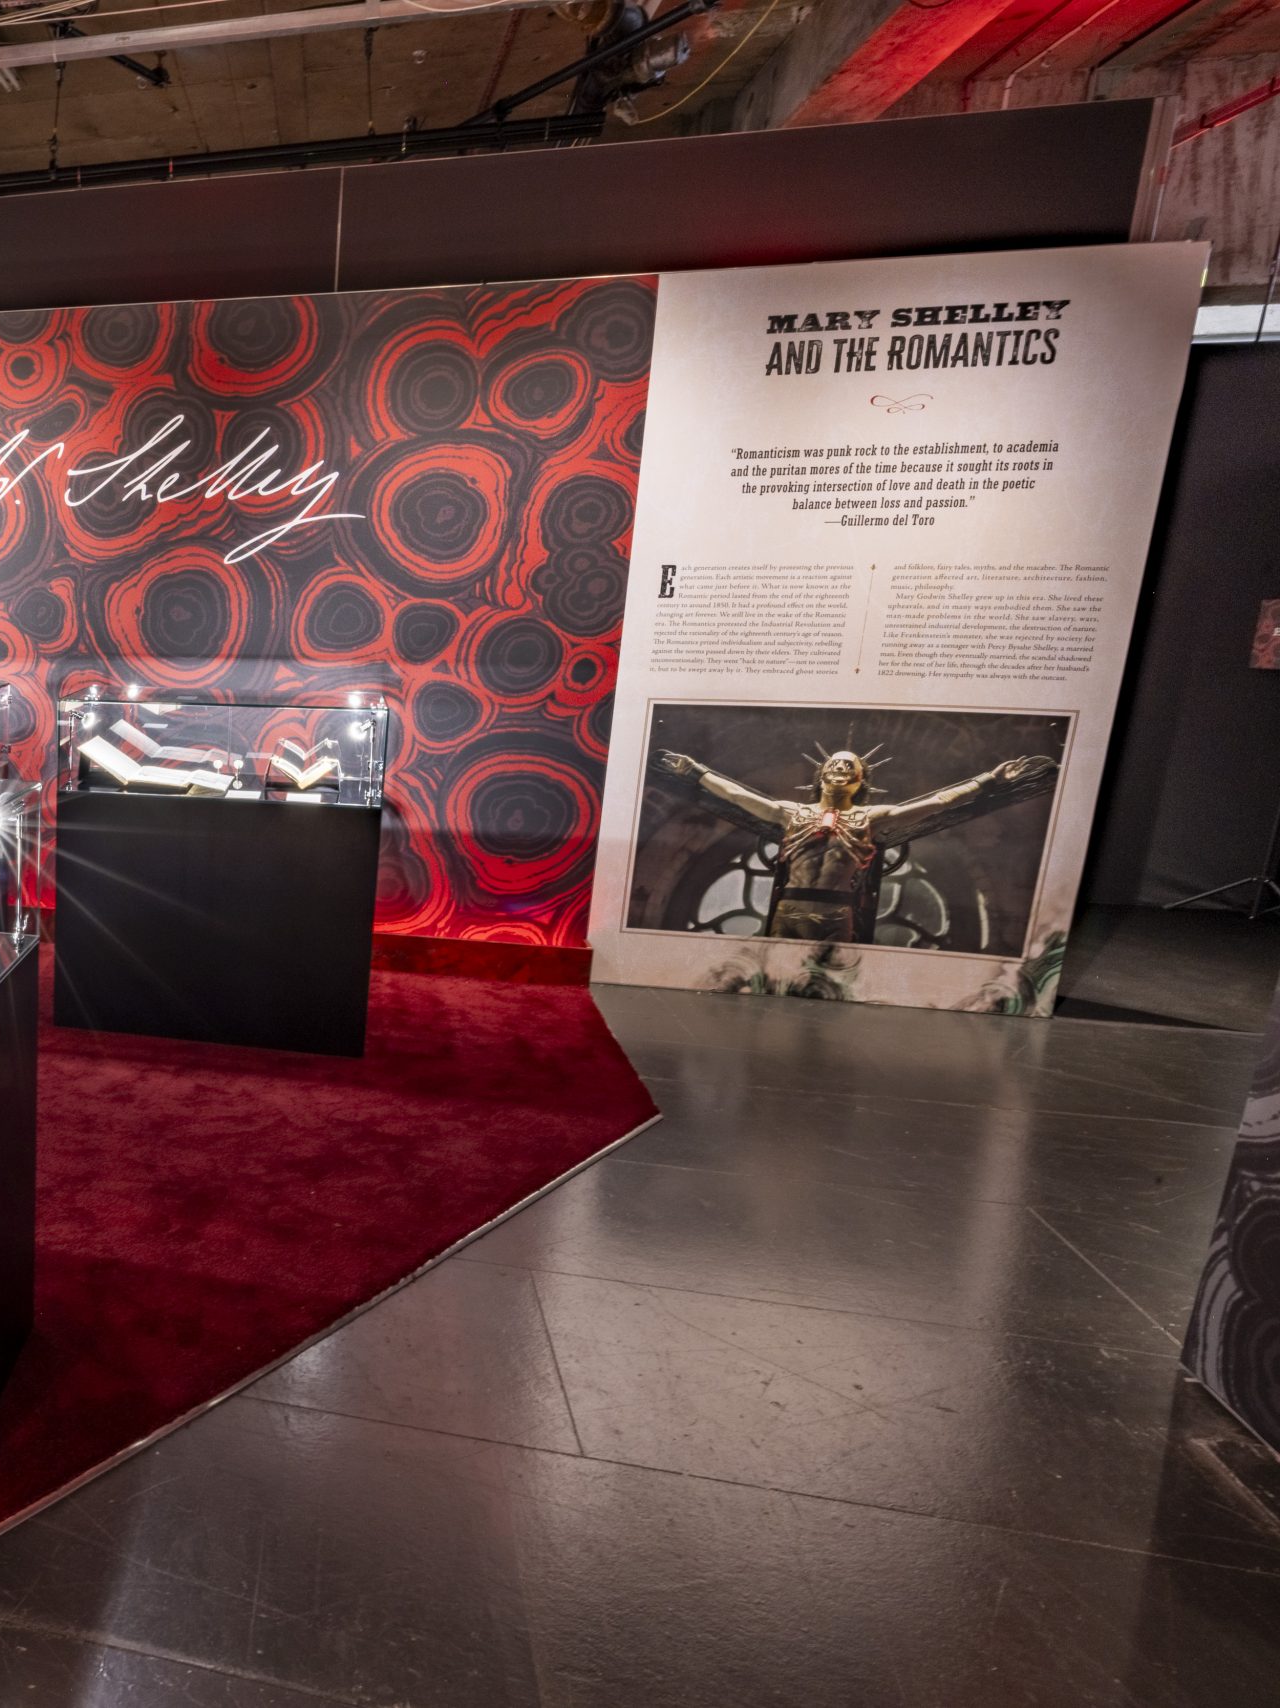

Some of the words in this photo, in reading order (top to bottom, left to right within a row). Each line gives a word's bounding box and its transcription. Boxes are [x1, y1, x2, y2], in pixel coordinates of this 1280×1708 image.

[766, 309, 881, 334] MARY
[890, 299, 1071, 328] SHELLEY
[765, 339, 823, 376] AND
[832, 336, 880, 373] THE
[886, 327, 1060, 371] ROMANTICS
[803, 448, 824, 457] was
[825, 444, 852, 459] punk
[854, 444, 877, 456] rock
[880, 445, 890, 456] to
[893, 443, 909, 455] the
[912, 441, 989, 455] establishment,
[992, 442, 1003, 453] to
[1006, 439, 1059, 453] academia
[730, 464, 749, 477] and
[751, 464, 767, 476] the
[769, 465, 806, 478] puritan
[809, 465, 840, 475] mores
[842, 462, 854, 474] of
[855, 461, 872, 474] the
[874, 463, 897, 474] time
[899, 461, 943, 473] because
[945, 461, 954, 472] it
[956, 459, 993, 474] sought
[995, 460, 1010, 471] its
[1011, 459, 1040, 471] roots
[1042, 461, 1053, 470] in
[66, 414, 366, 565] Shelley
[741, 481, 757, 494] the
[759, 480, 810, 496] provoking
[812, 481, 873, 492] intersection
[875, 478, 888, 491] of
[888, 478, 910, 491] love
[913, 478, 933, 490] and
[935, 477, 965, 490] death
[968, 480, 979, 490] in
[982, 477, 999, 489] the
[1001, 478, 1036, 492] poetic
[791, 497, 832, 510] balance
[834, 497, 877, 509] between
[879, 496, 900, 508] loss
[903, 495, 923, 508] and
[892, 513, 908, 526] del
[911, 513, 935, 526] Toro
